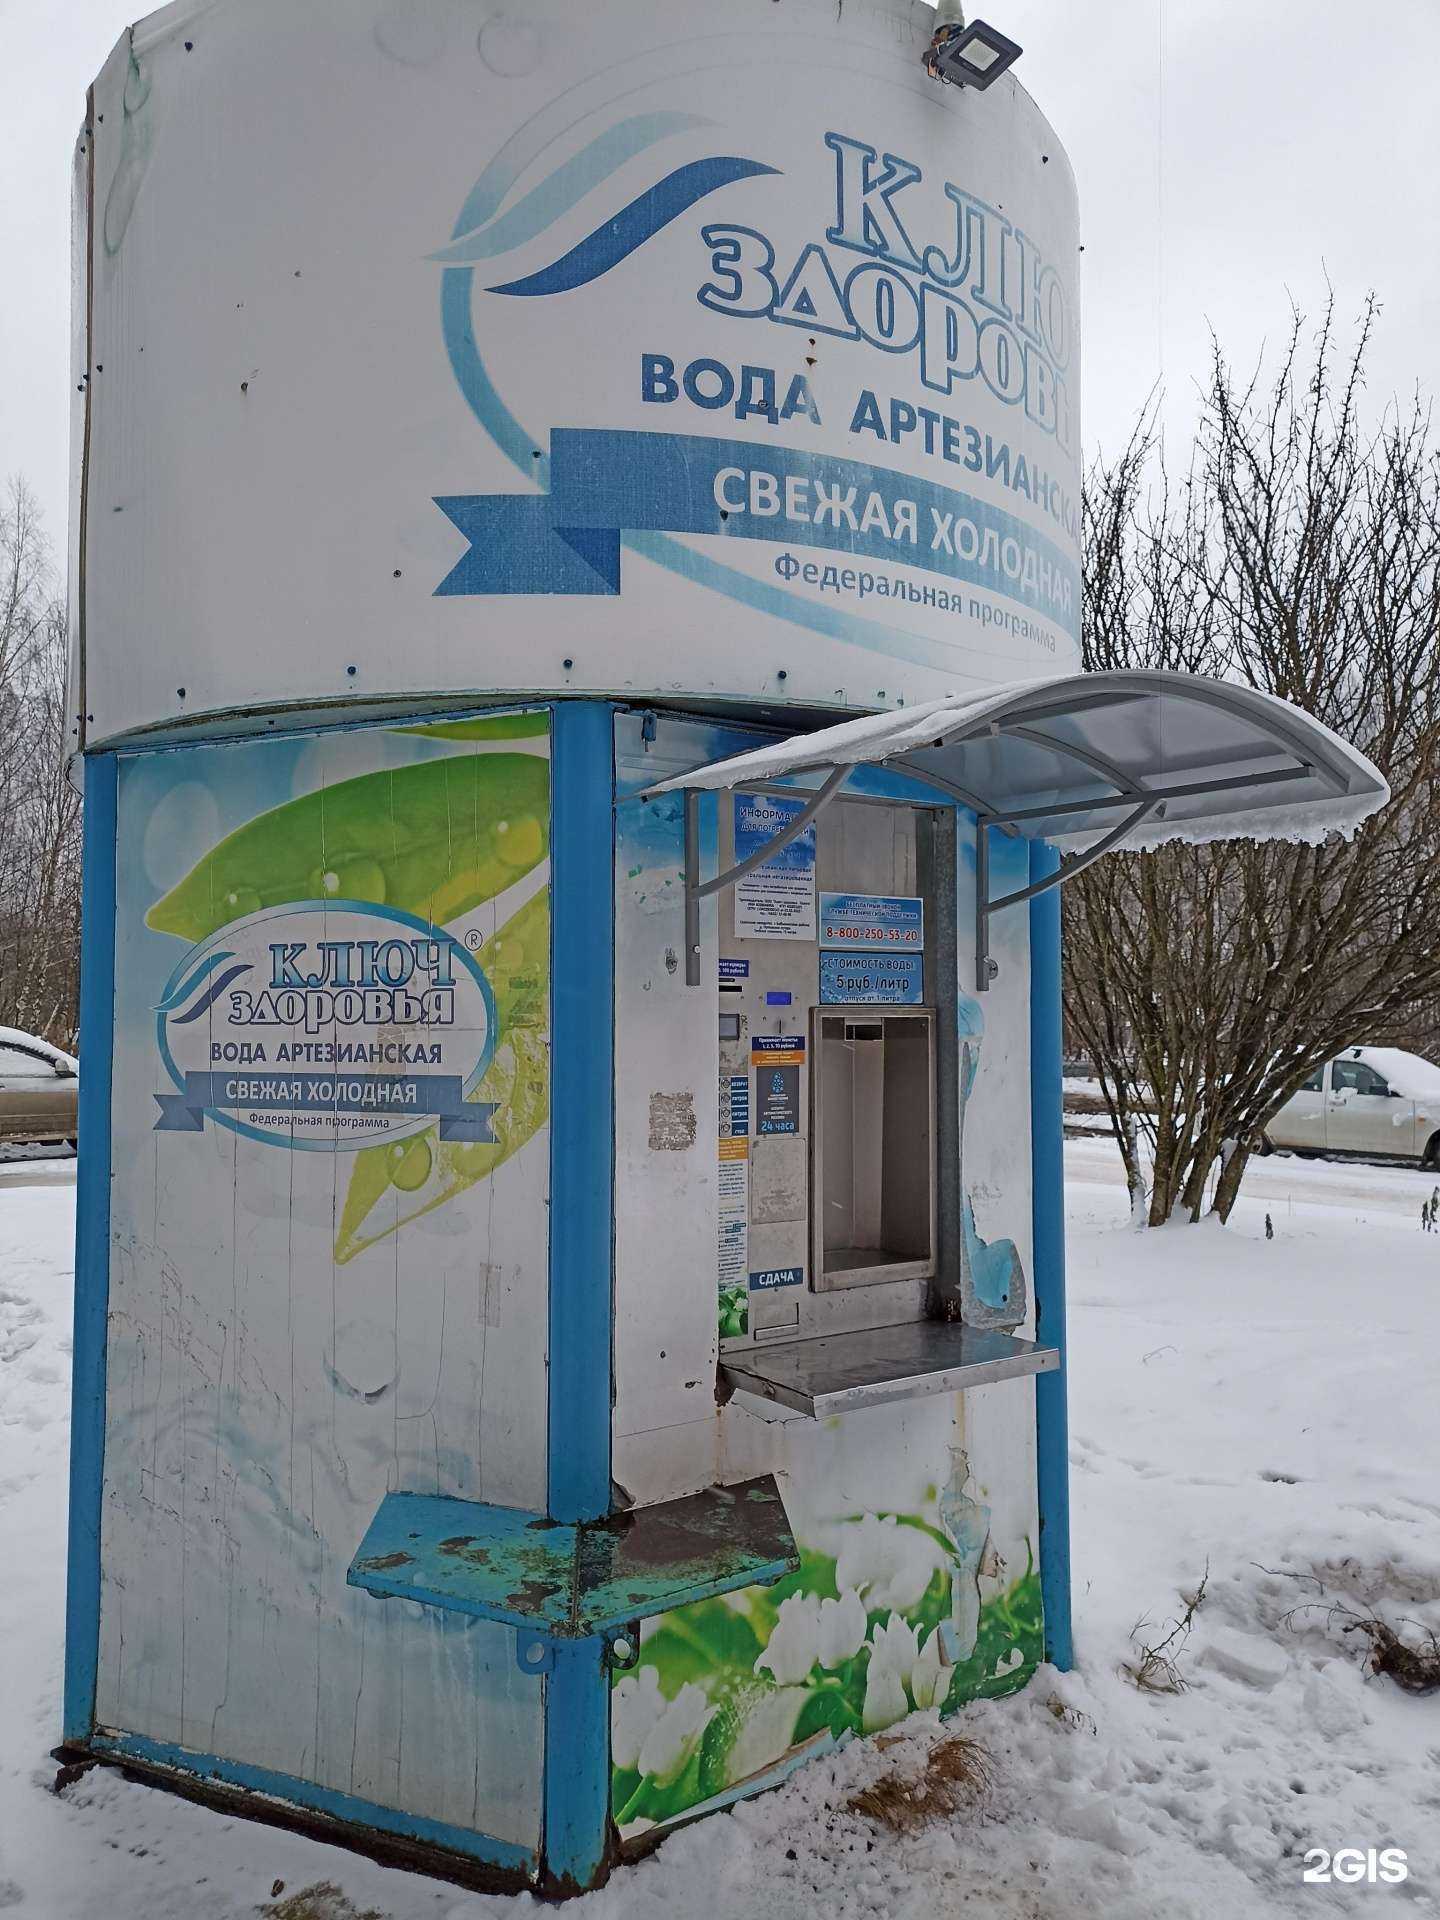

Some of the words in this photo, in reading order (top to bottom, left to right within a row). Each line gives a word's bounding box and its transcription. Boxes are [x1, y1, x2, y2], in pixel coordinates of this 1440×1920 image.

[641, 353, 822, 425] ВОДА
[713, 467, 918, 545] СВЕЖАЯ
[930, 507, 1073, 615] ХОЛОДНАЯ
[774, 552, 963, 614] Федеральная
[968, 598, 1057, 652] программа
[826, 926, 918, 941] 8-800-250-53-20
[268, 938, 457, 989] КЛЮЧ
[827, 958, 885, 970] СТОИМОСТЬ
[887, 959, 913, 971] ВОДЫ
[837, 974, 844, 989] 5
[847, 974, 910, 993] руб./литр
[228, 988, 455, 1034] ЗДОРОВЬЯ
[211, 1042, 266, 1064] ВОДА
[276, 1042, 443, 1064] АРТЕЗИАНСКАЯ
[225, 1079, 302, 1102] СВЕЖАЯ
[307, 1081, 418, 1106] ХОЛОДНАЯ
[249, 1112, 323, 1130] Федеральная
[325, 1116, 390, 1130] программа
[761, 1120, 773, 1132] 24
[775, 1121, 795, 1131] часа
[759, 1273, 795, 1287] СДАЧА
